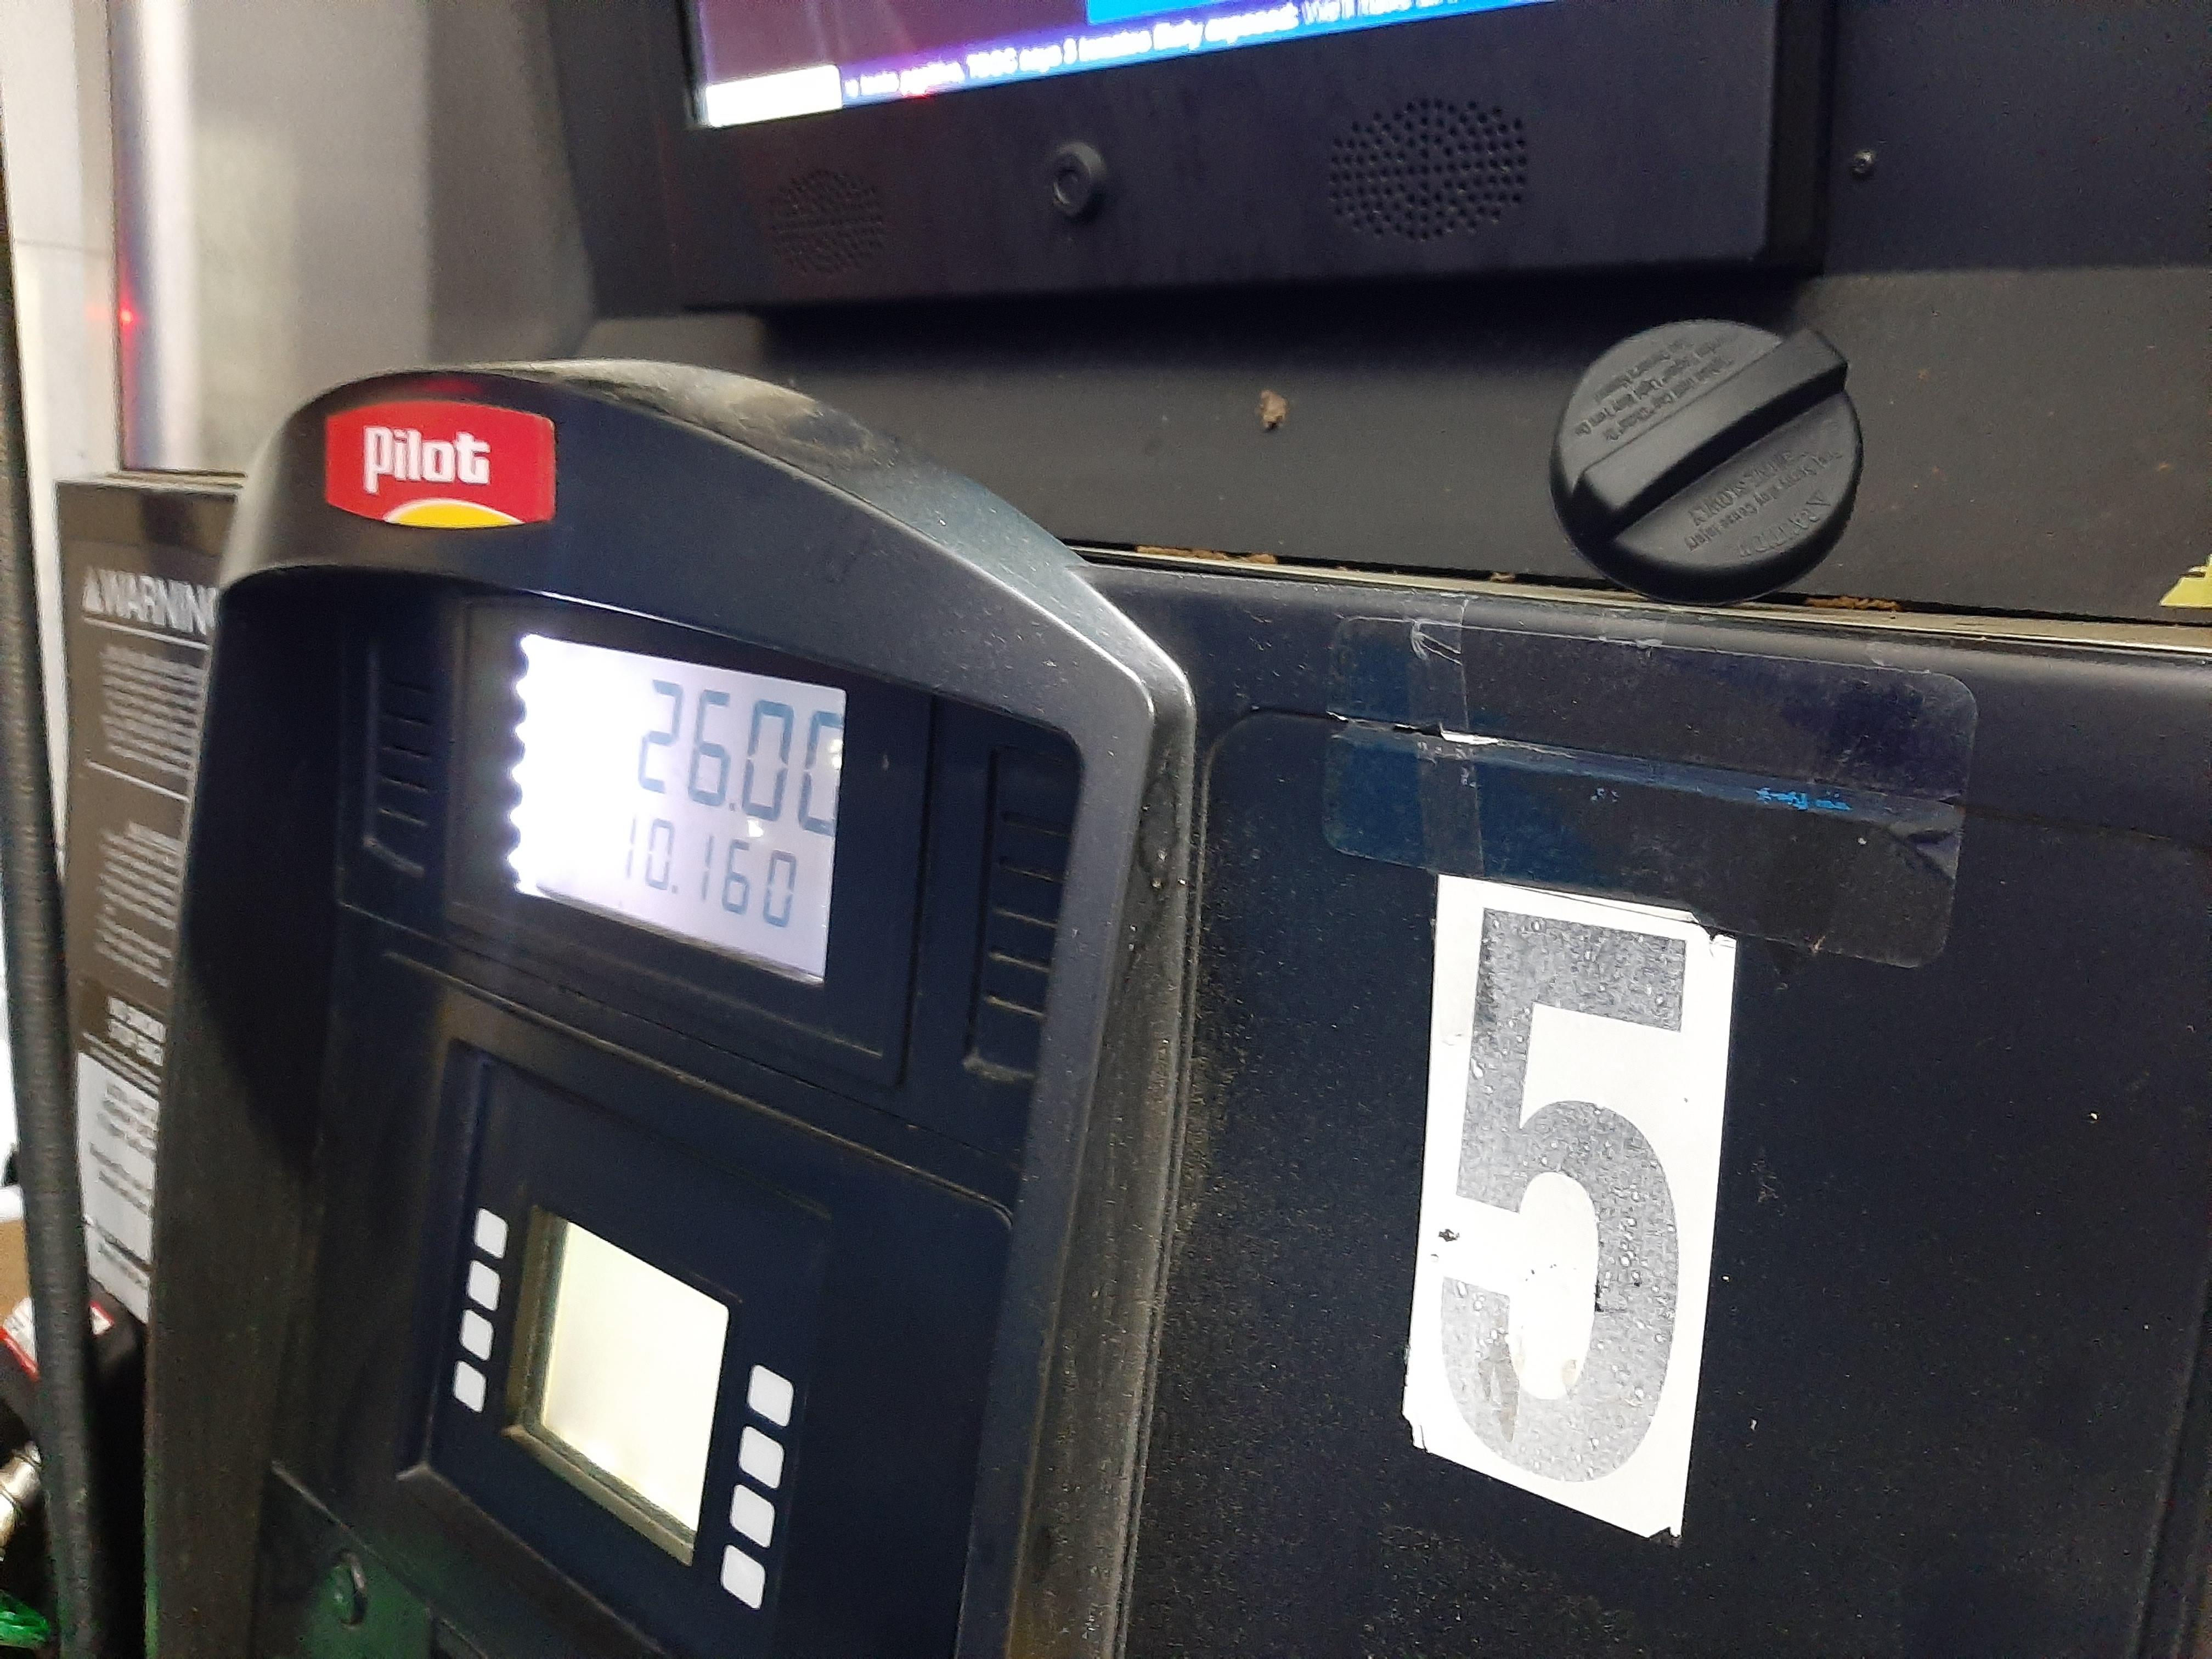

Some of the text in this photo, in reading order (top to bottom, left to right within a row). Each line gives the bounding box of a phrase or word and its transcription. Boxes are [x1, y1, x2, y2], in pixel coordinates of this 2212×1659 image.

[363, 426, 491, 495] Pilot
[627, 812, 796, 927] 10.160
[1441, 907, 1687, 1482] 5
